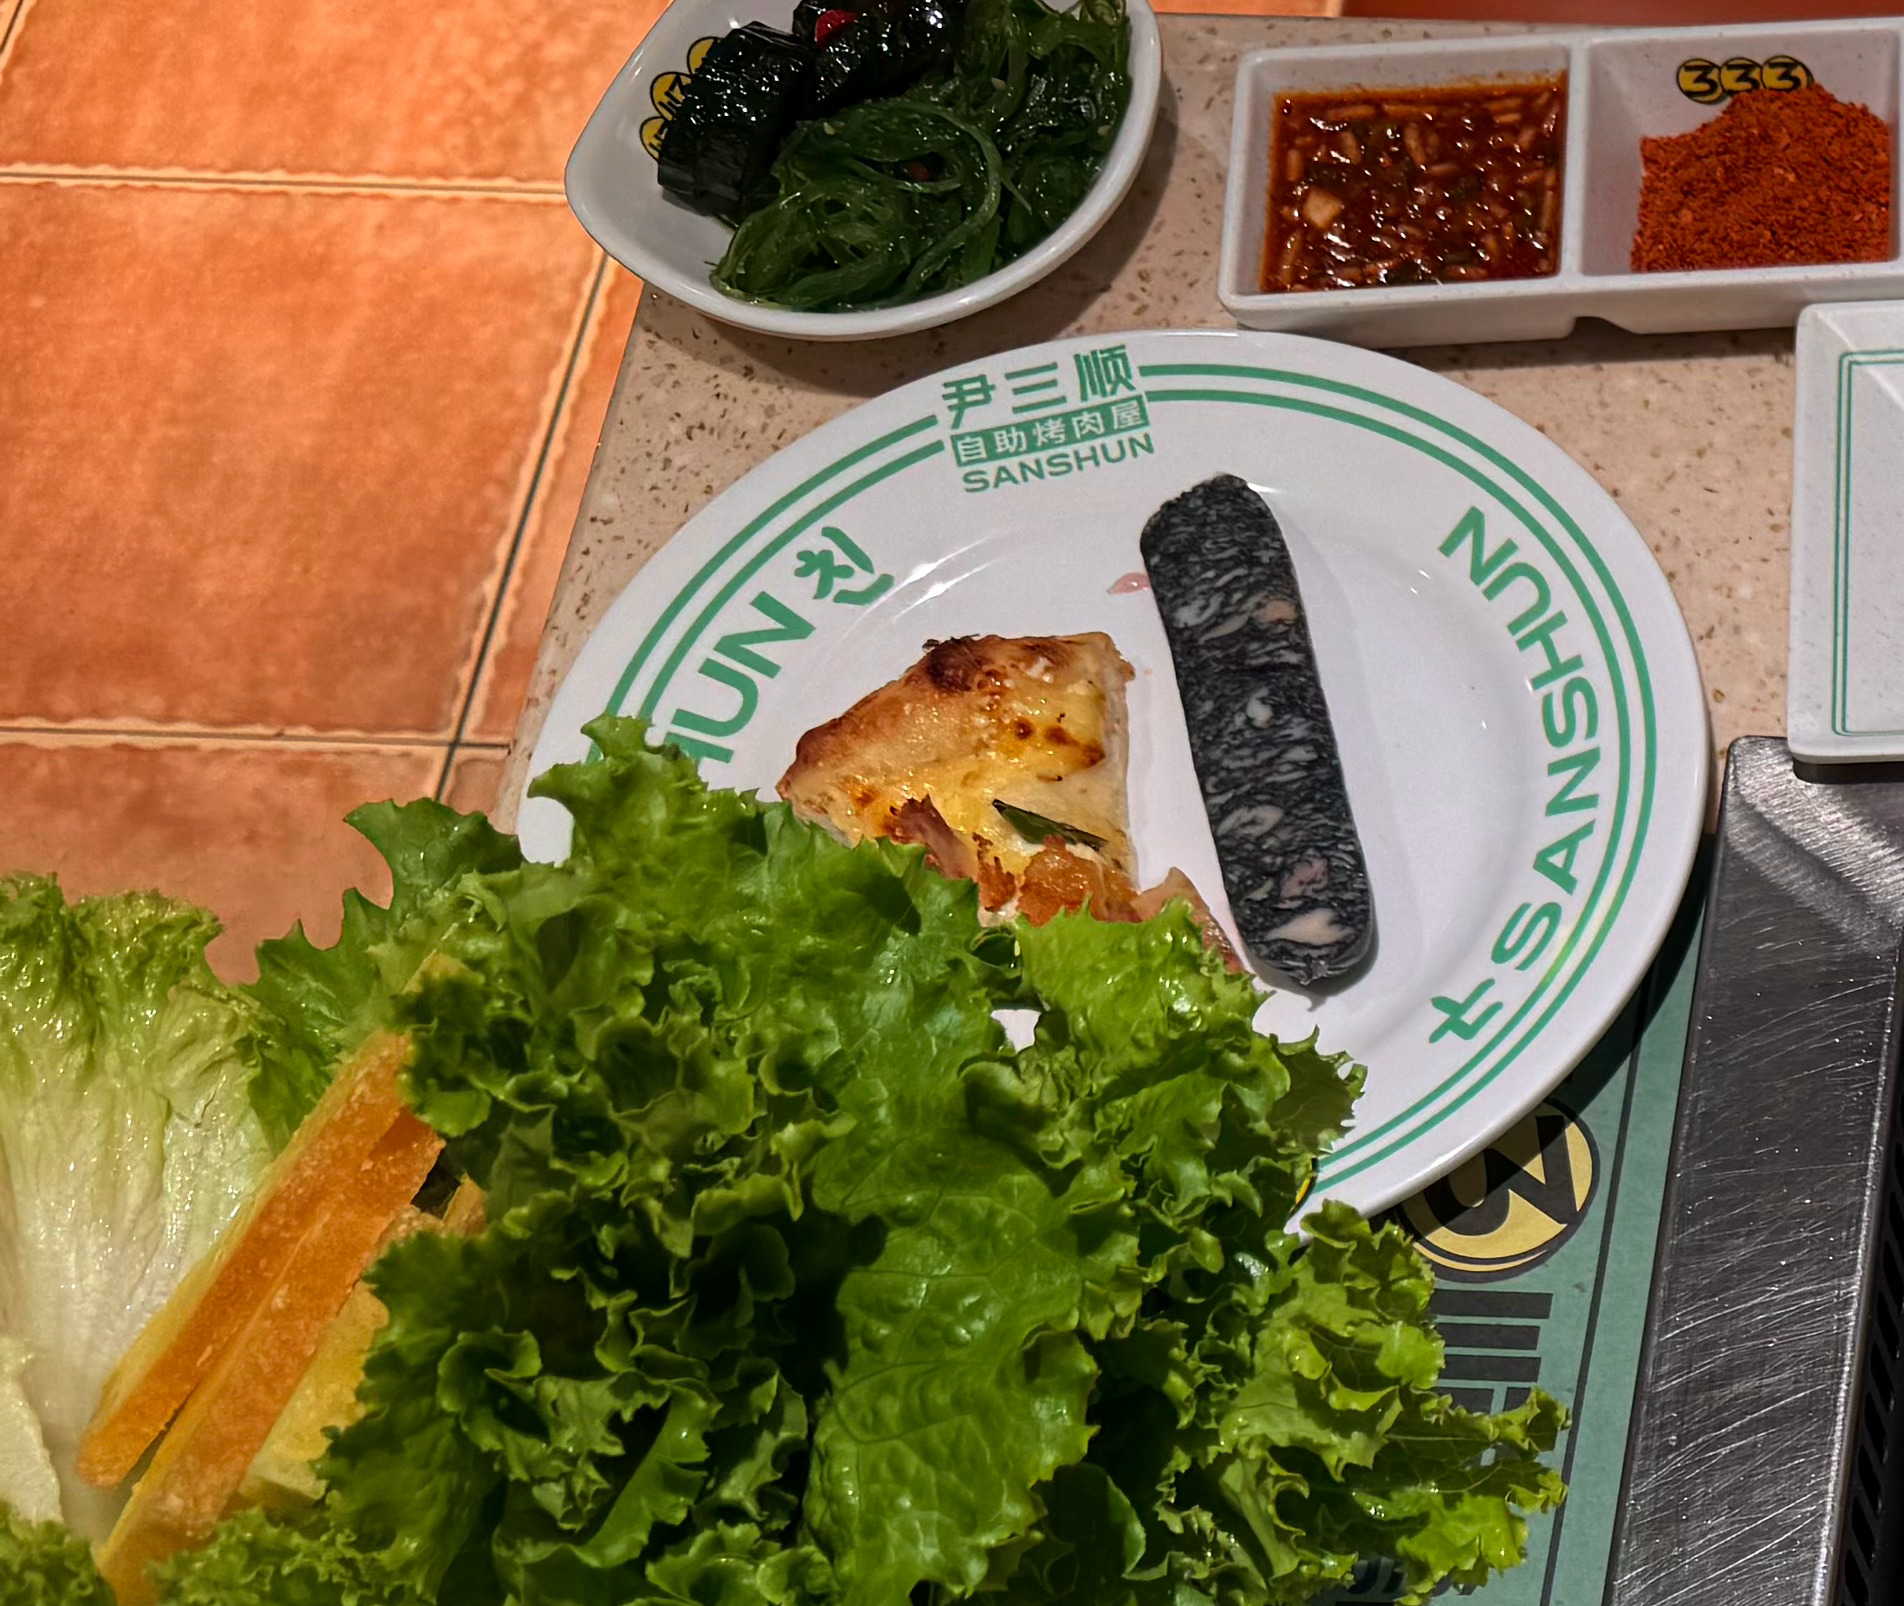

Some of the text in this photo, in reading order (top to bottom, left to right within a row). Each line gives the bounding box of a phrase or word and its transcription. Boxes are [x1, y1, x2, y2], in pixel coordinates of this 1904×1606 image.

[942, 345, 1135, 429] 尹三顺
[956, 399, 1146, 464] 自助烤肉屋
[962, 433, 1154, 493] SANSHUN
[1438, 506, 1601, 971] SANSHUN
